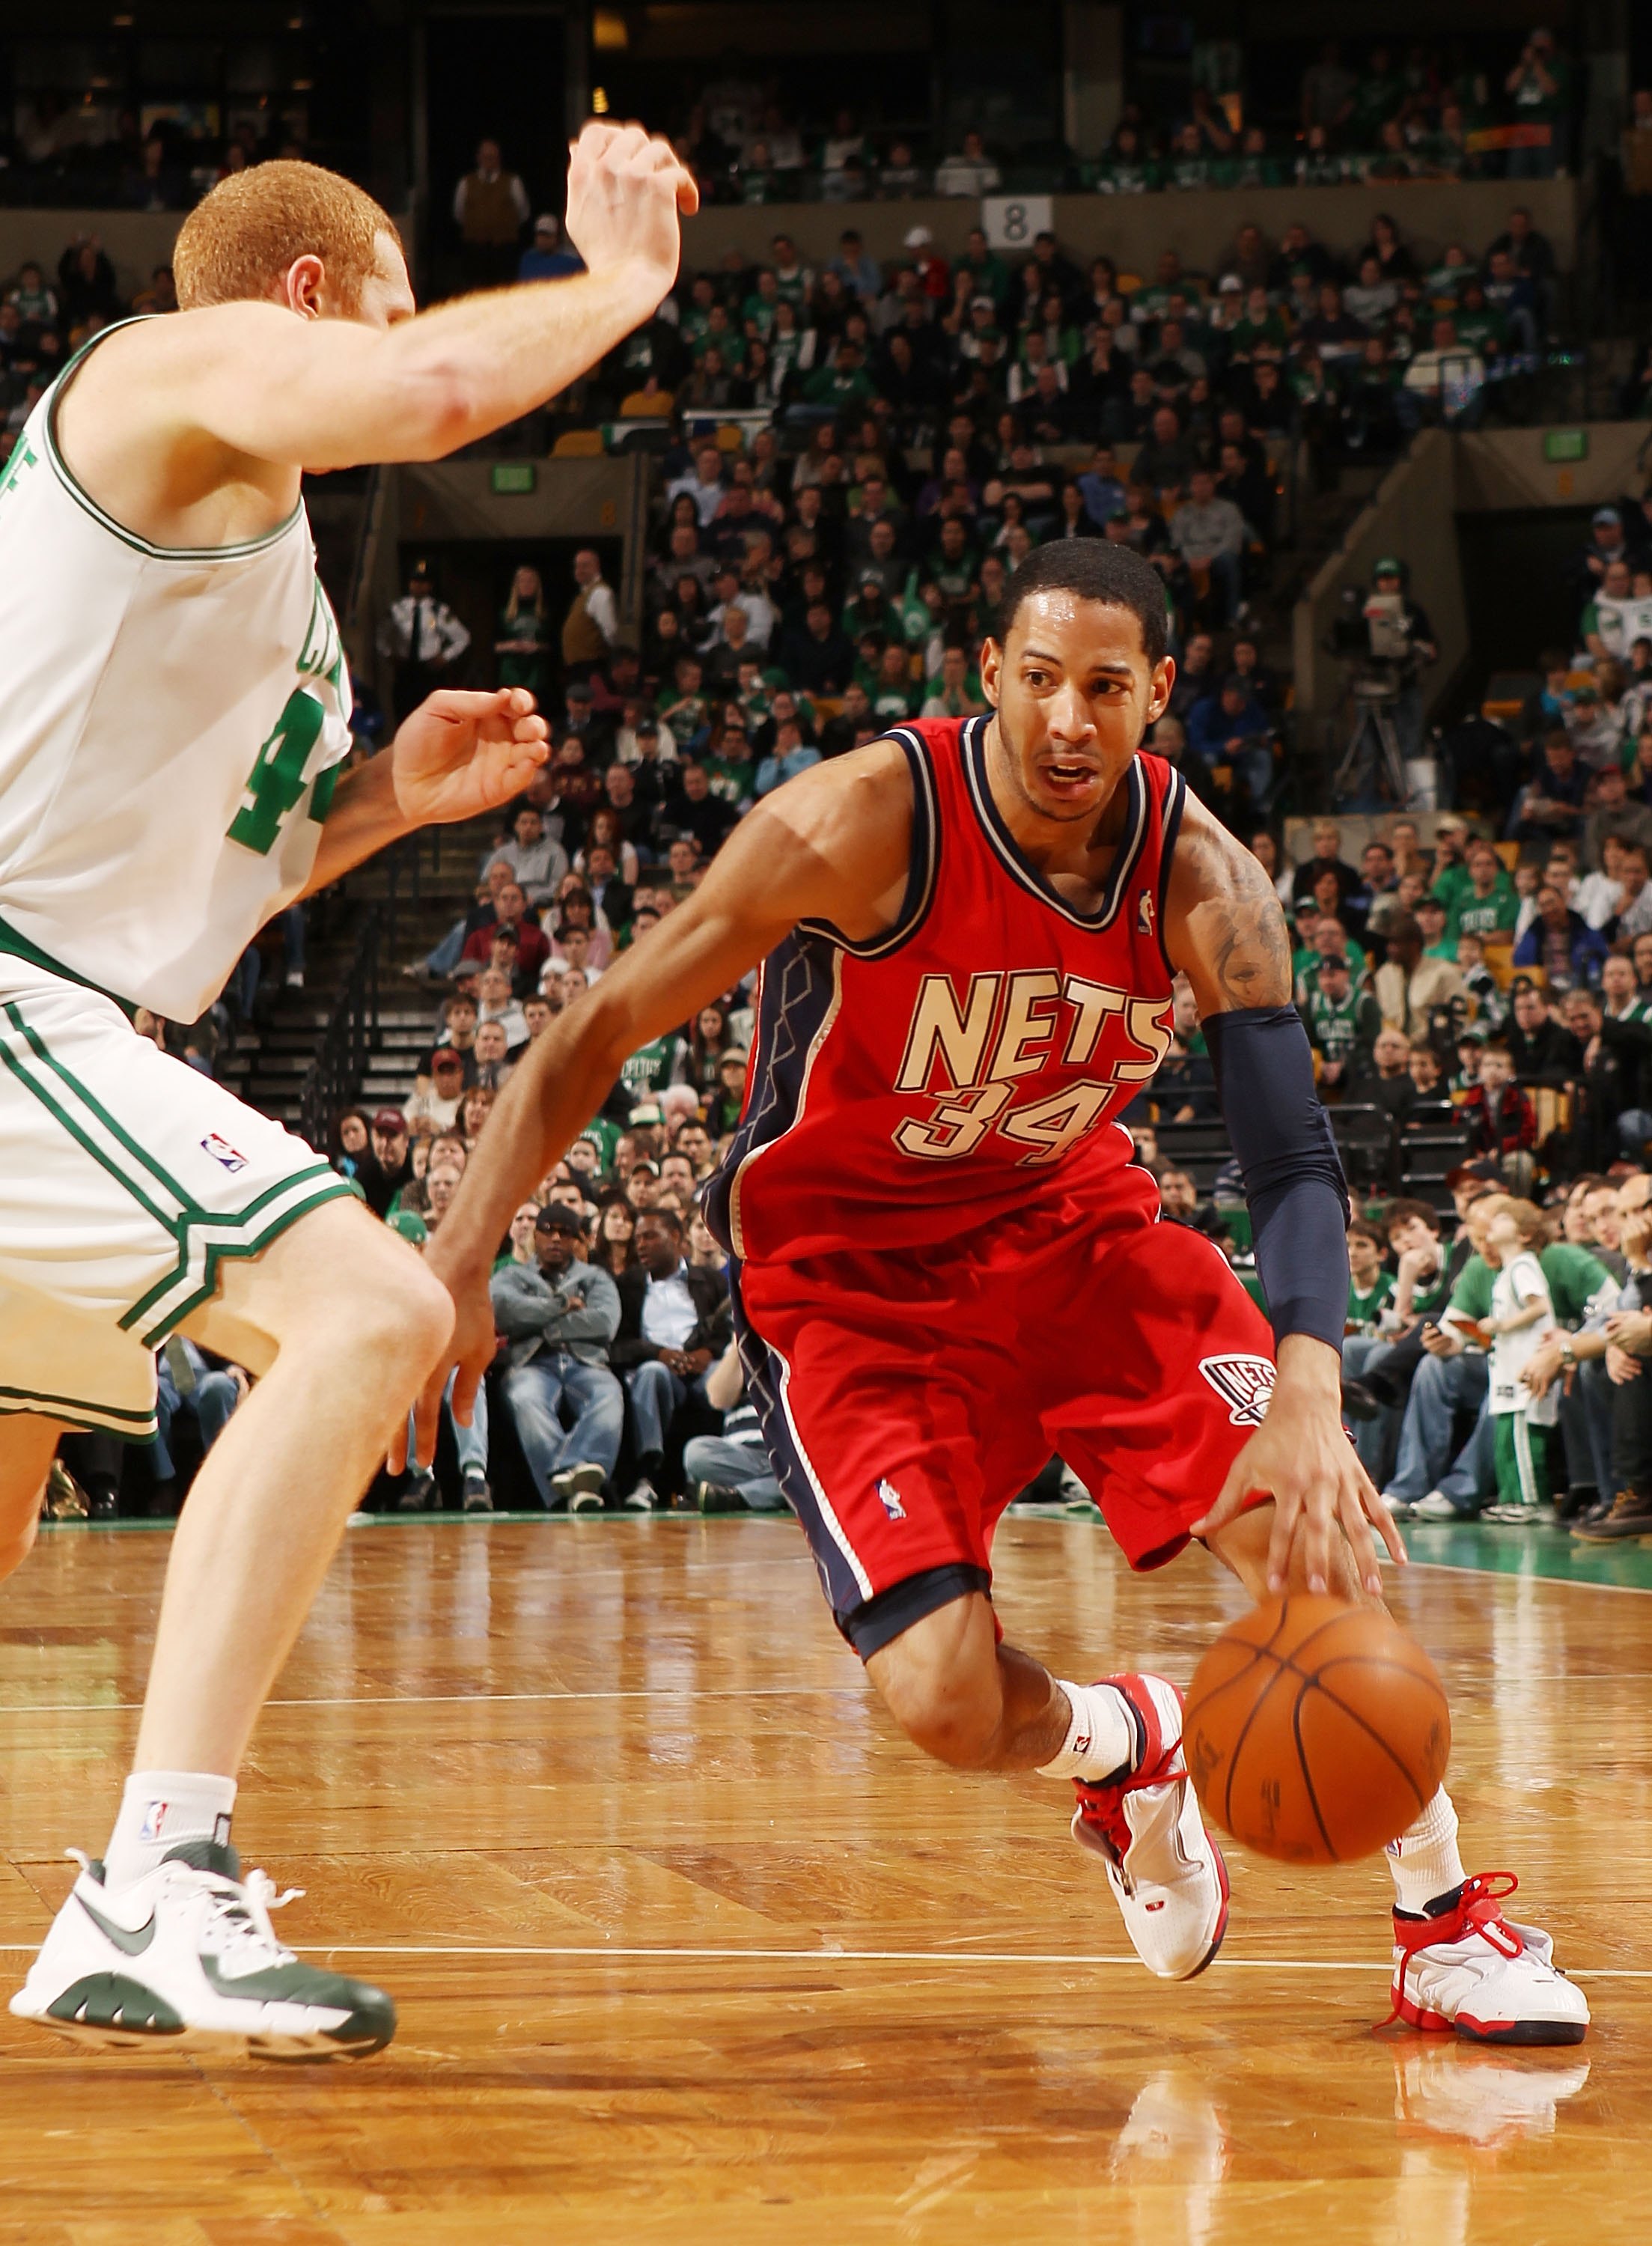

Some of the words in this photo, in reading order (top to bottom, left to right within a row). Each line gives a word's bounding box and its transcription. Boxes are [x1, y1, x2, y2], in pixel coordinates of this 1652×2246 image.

[1005, 203, 1028, 241] 8
[893, 968, 1174, 1094] NETS
[891, 1078, 1118, 1168] 34
[1216, 1361, 1276, 1402] NETS
